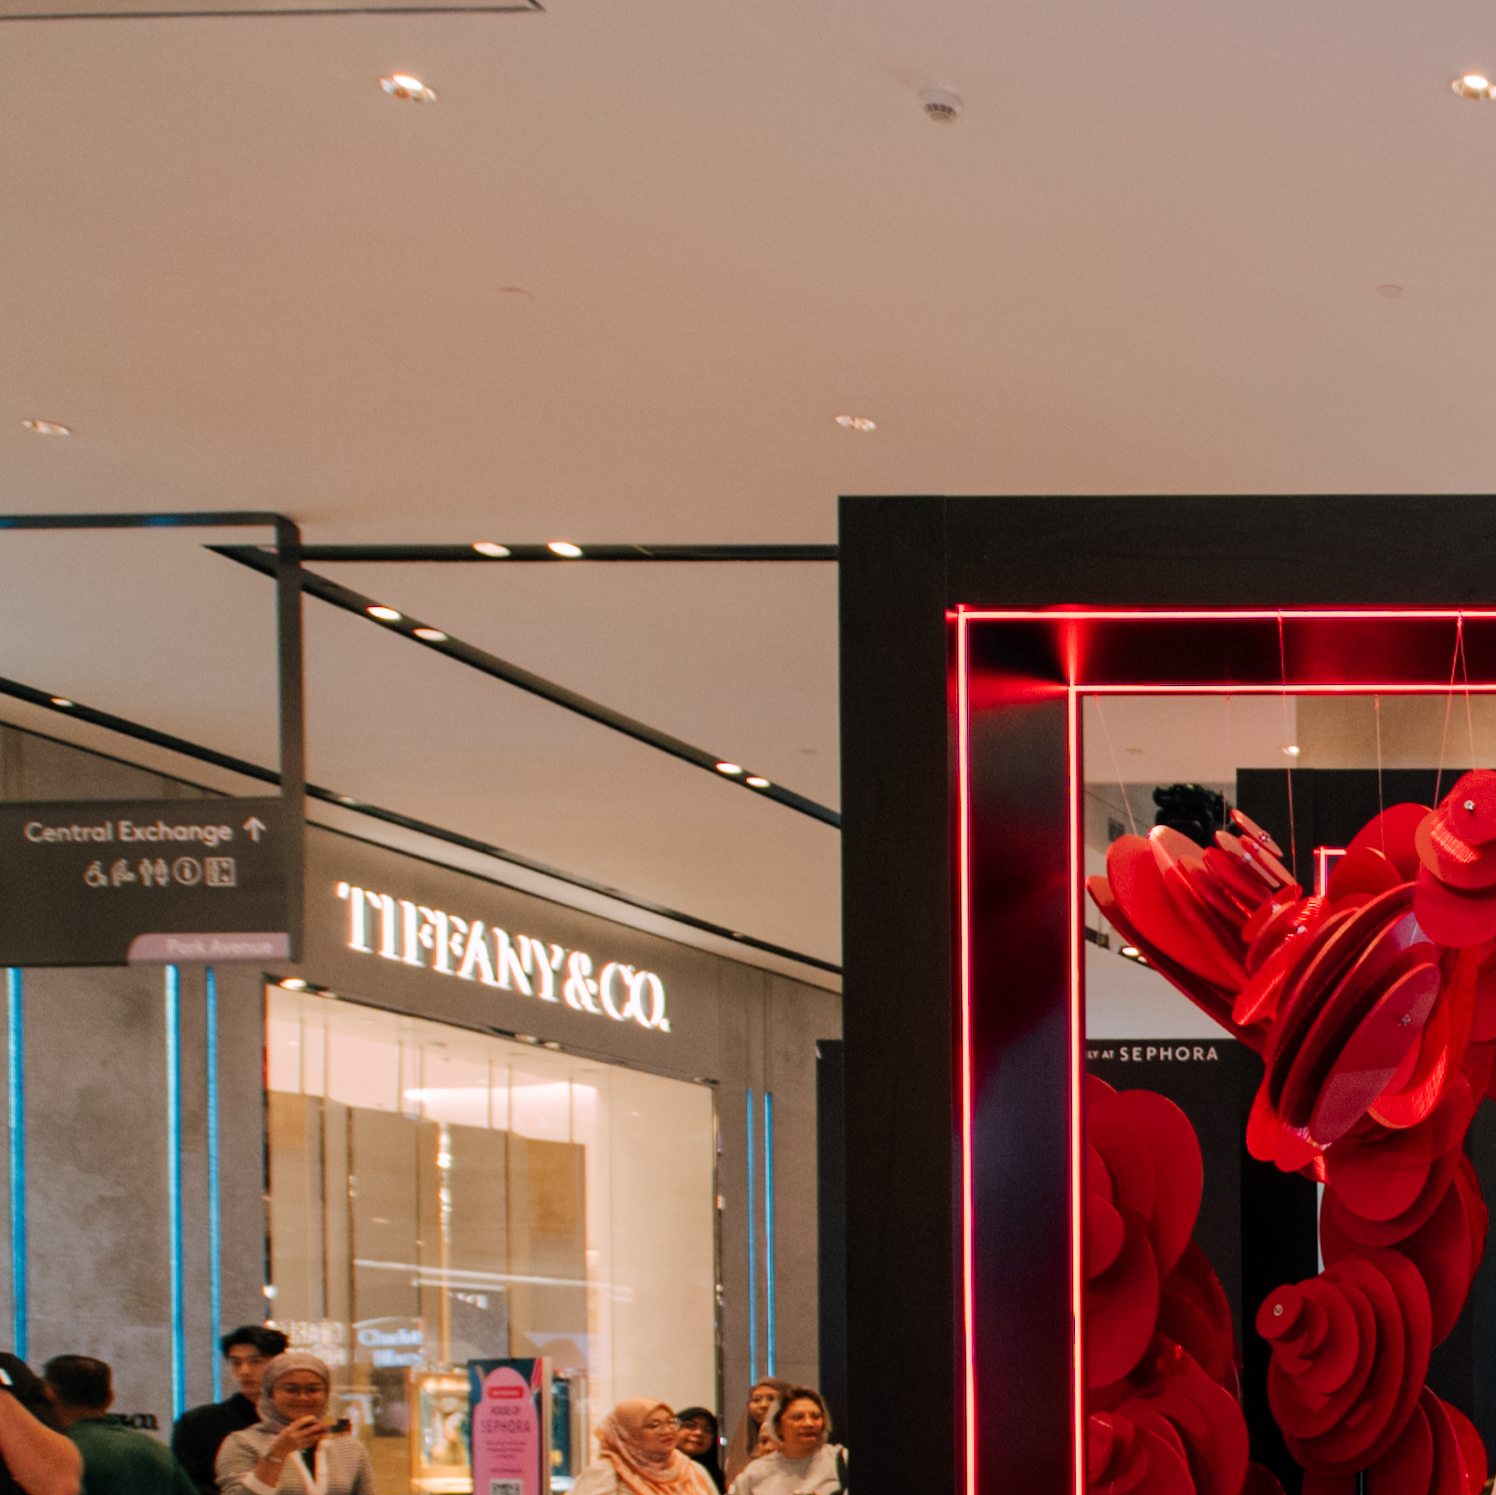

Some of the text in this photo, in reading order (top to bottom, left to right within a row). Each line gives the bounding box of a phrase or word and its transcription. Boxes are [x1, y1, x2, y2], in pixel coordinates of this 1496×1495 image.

[24, 821, 233, 848] Central Exchange
[166, 939, 273, 954] Park Avenue
[1087, 1046, 1218, 1061] LY AT SEPHORA
